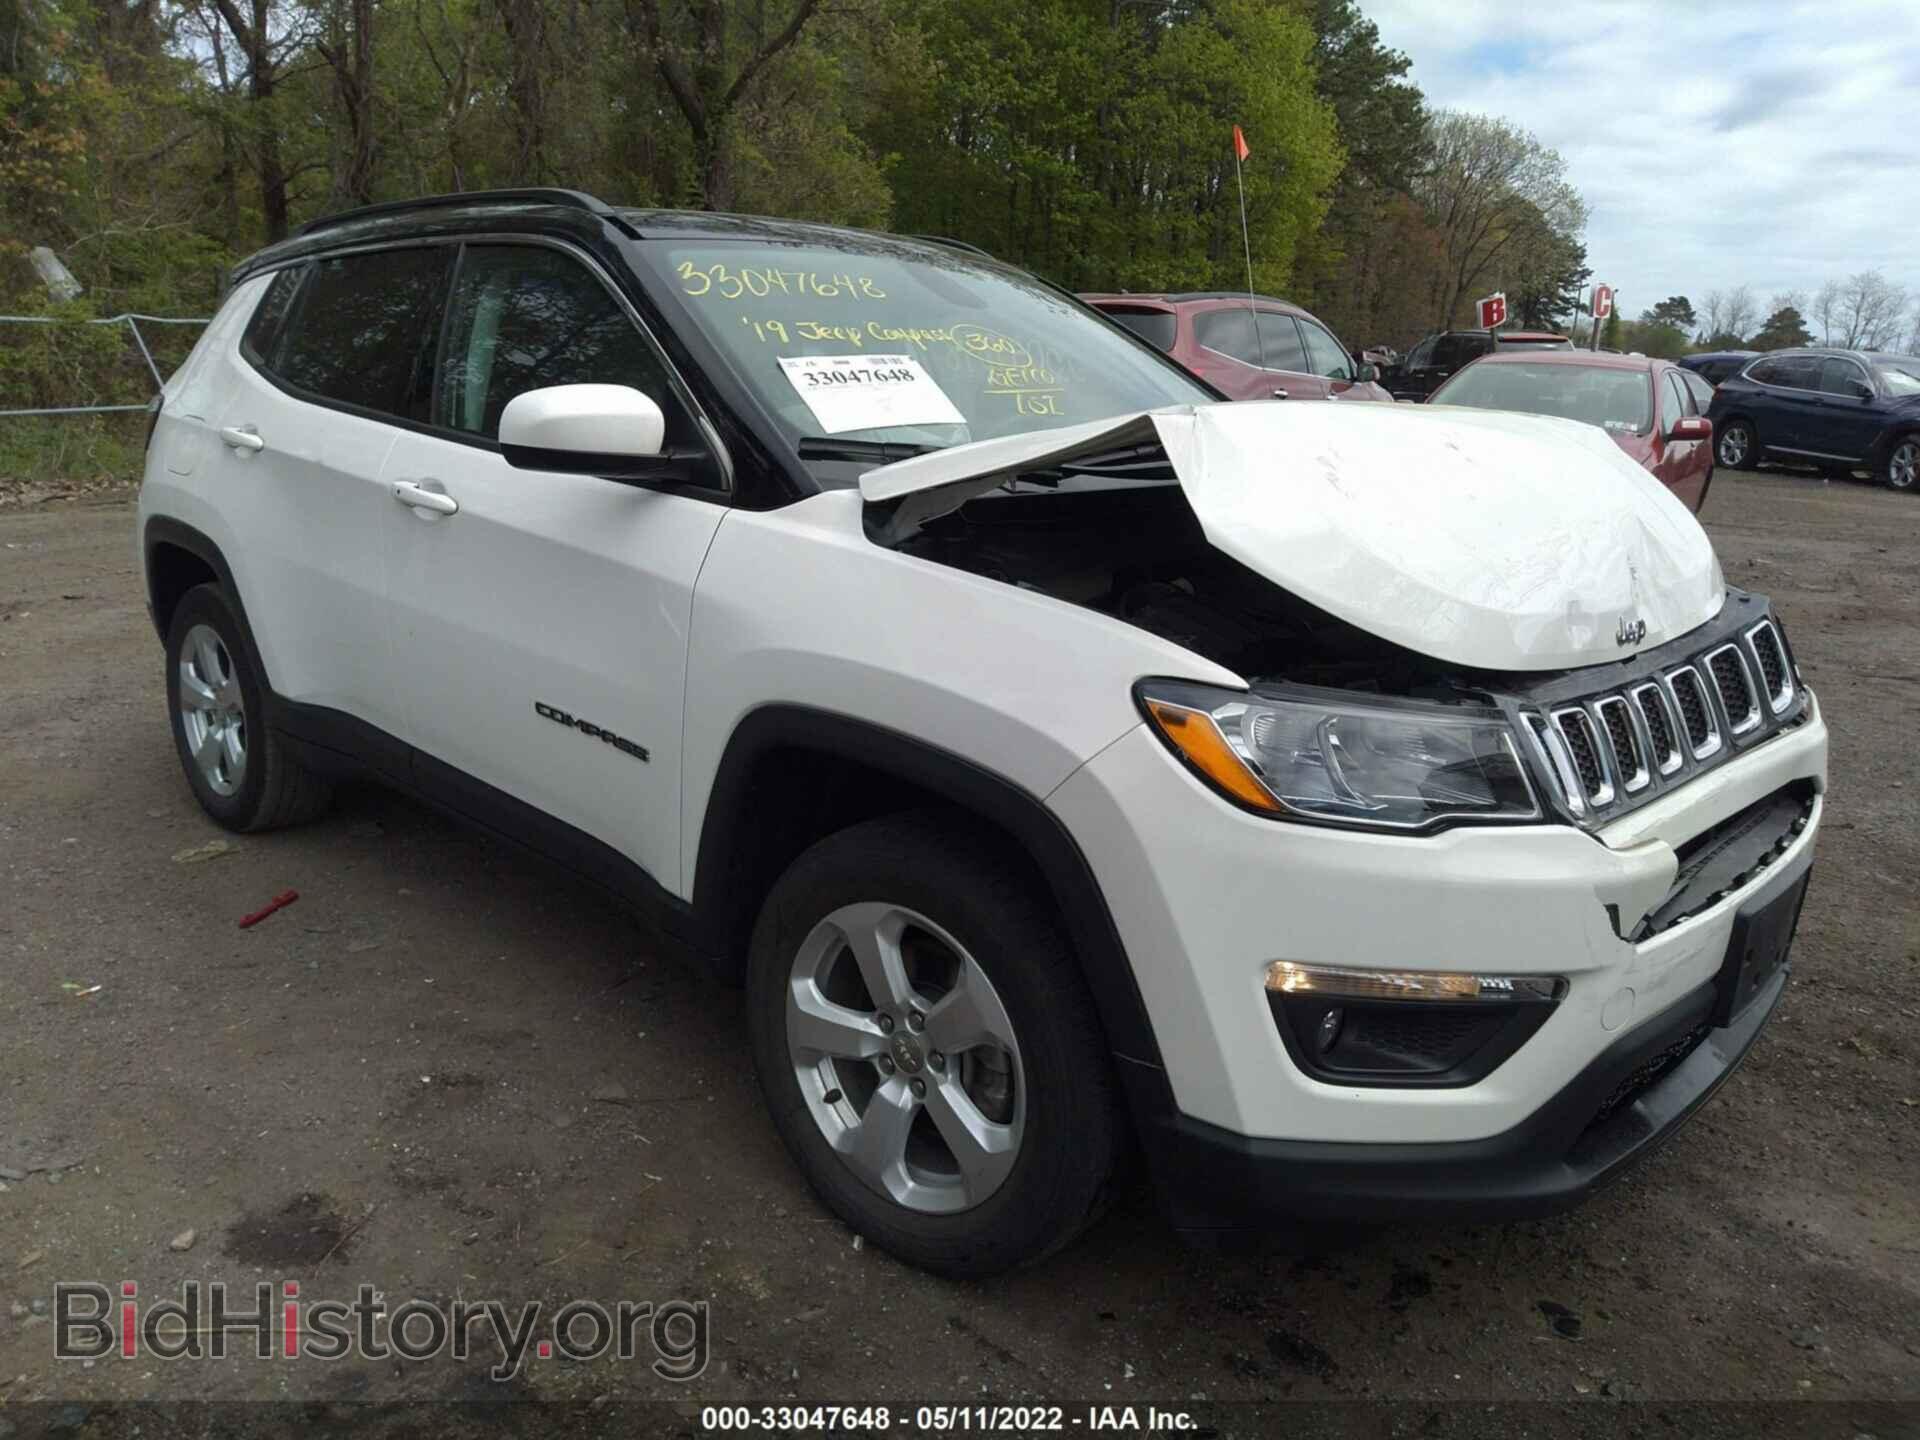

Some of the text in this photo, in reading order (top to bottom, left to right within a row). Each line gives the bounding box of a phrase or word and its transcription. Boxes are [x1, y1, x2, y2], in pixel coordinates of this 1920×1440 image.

[676, 261, 887, 300] 33047648
[1482, 297, 1505, 329] B
[1595, 286, 1612, 317] C
[795, 321, 863, 347] Jeep
[803, 368, 915, 386] 33047648
[534, 701, 650, 762] COMPASS
